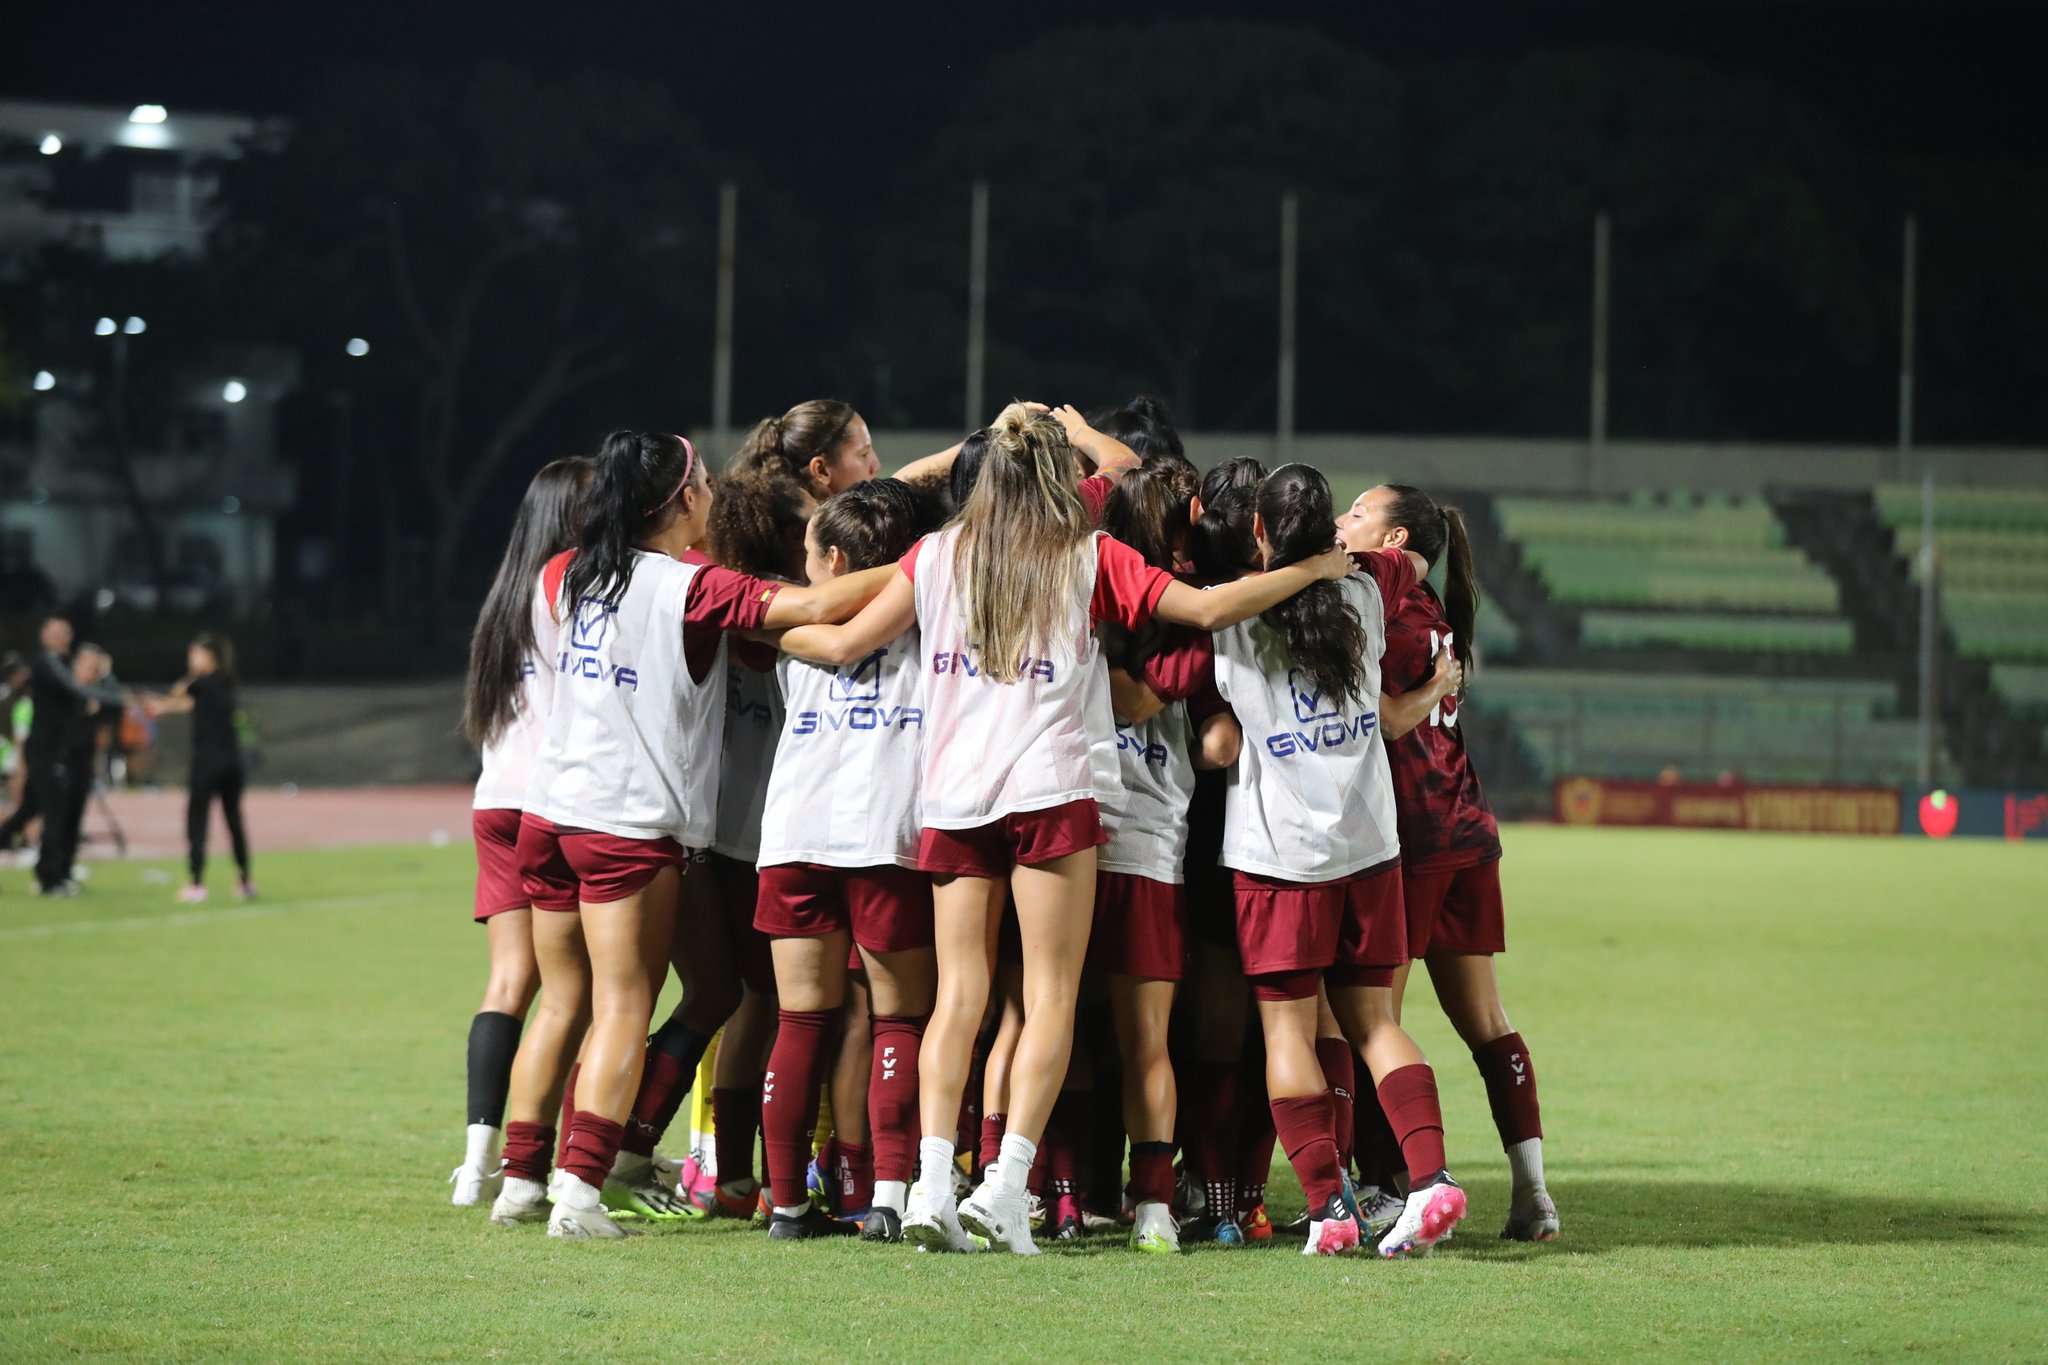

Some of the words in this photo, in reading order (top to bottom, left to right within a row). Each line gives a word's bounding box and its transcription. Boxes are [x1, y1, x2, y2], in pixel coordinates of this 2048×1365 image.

[792, 705, 924, 734] GIVOVA
[882, 1047, 897, 1080] FVF
[1510, 1053, 1526, 1085] FVF
[764, 1071, 775, 1104] FVF
